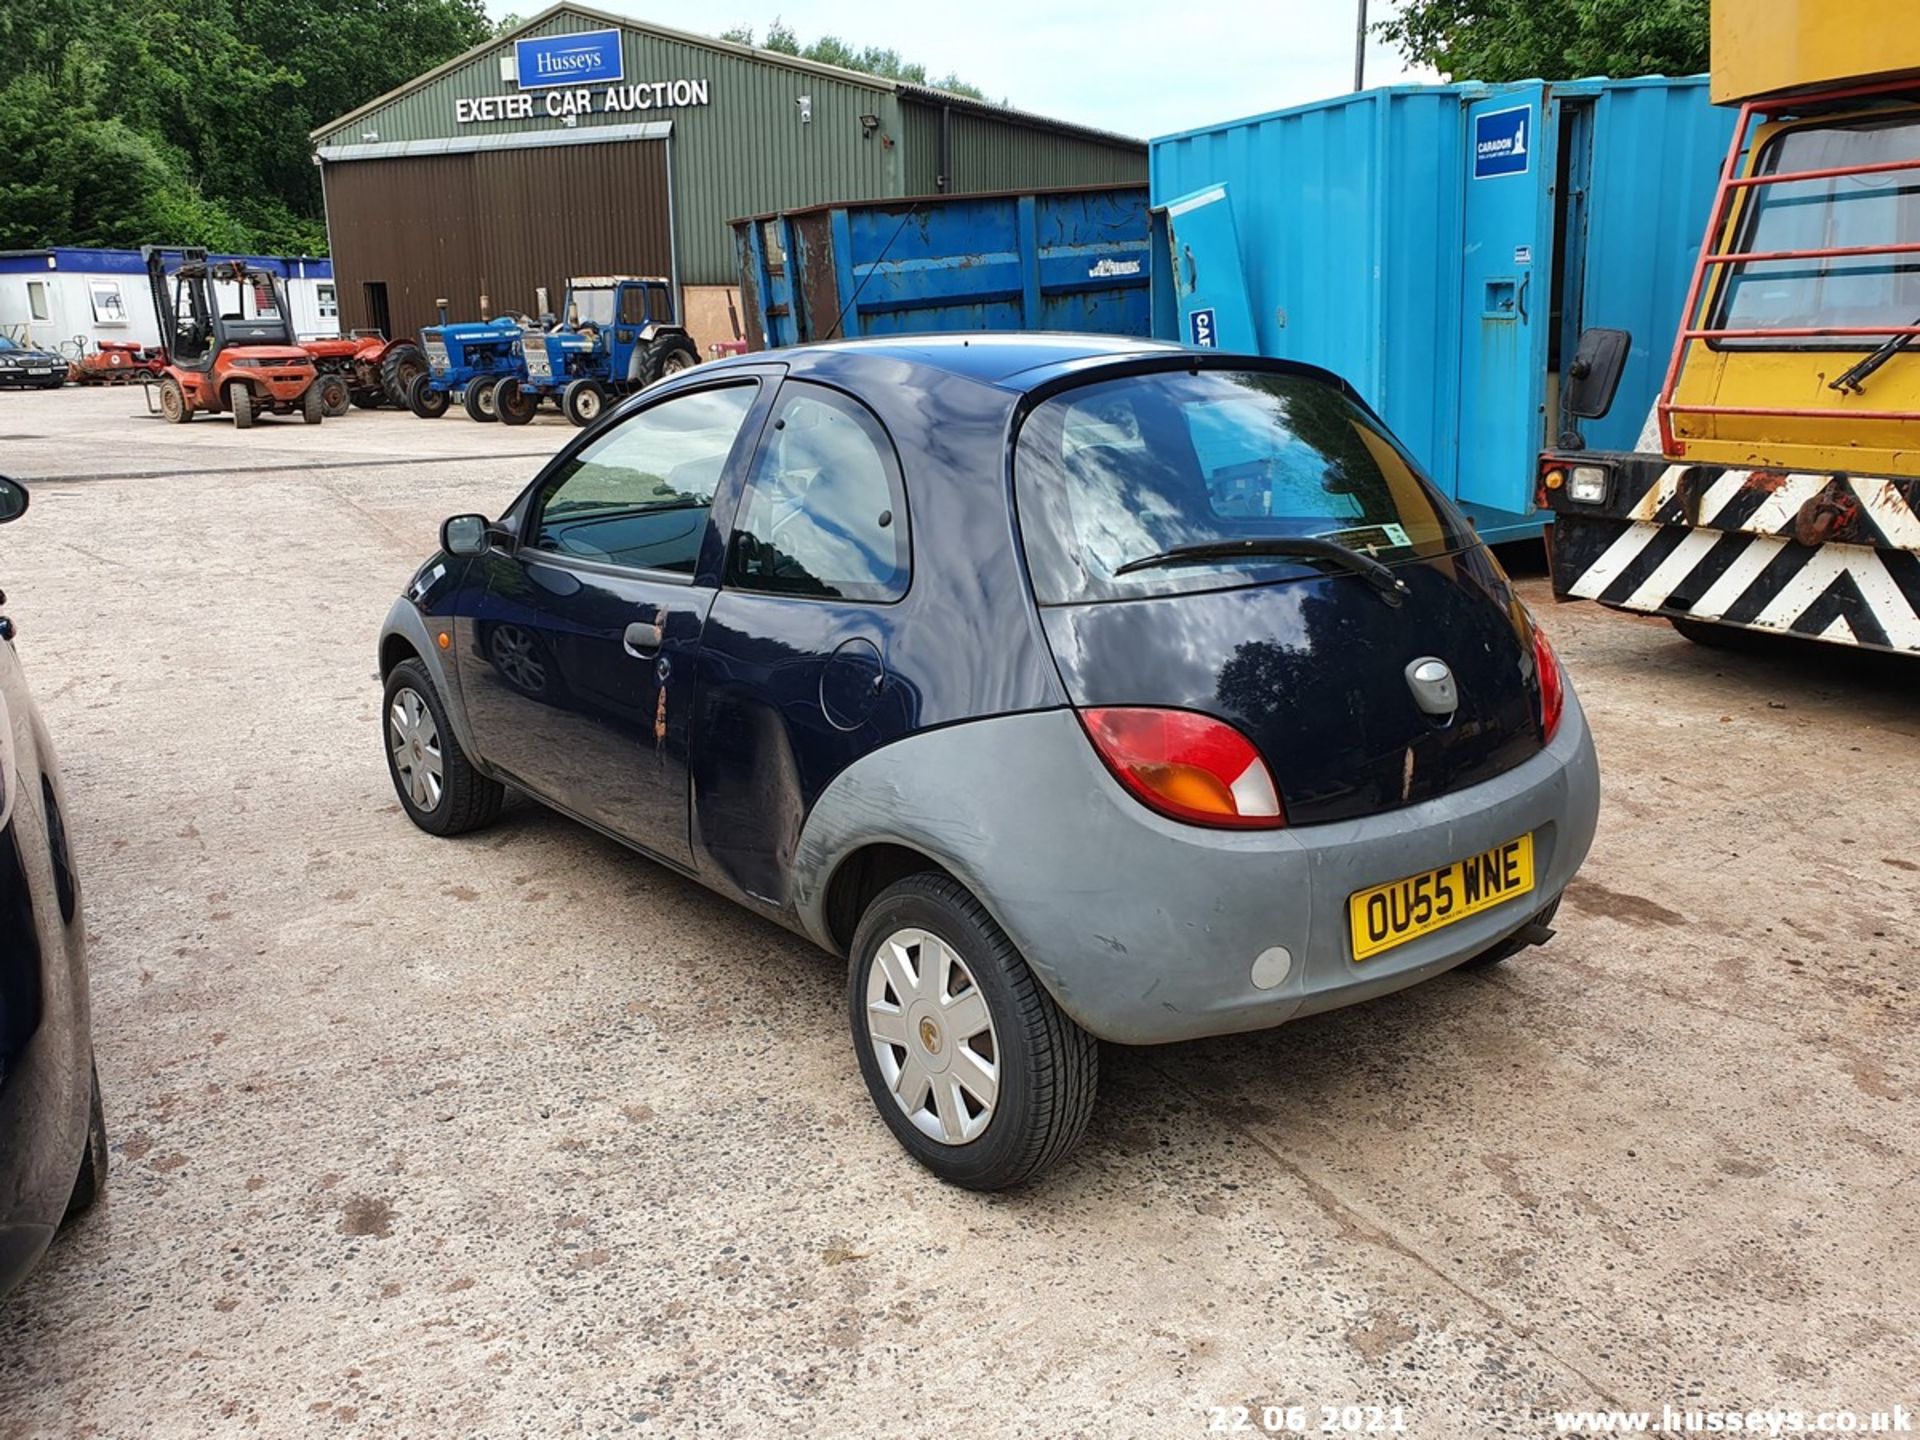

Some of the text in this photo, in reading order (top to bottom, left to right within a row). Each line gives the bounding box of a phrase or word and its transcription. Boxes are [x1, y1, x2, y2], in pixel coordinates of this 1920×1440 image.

[537, 51, 602, 73] Husseys
[456, 79, 708, 122] EXETER CAR AUCTION
[1367, 843, 1521, 943] OU55 WNE
